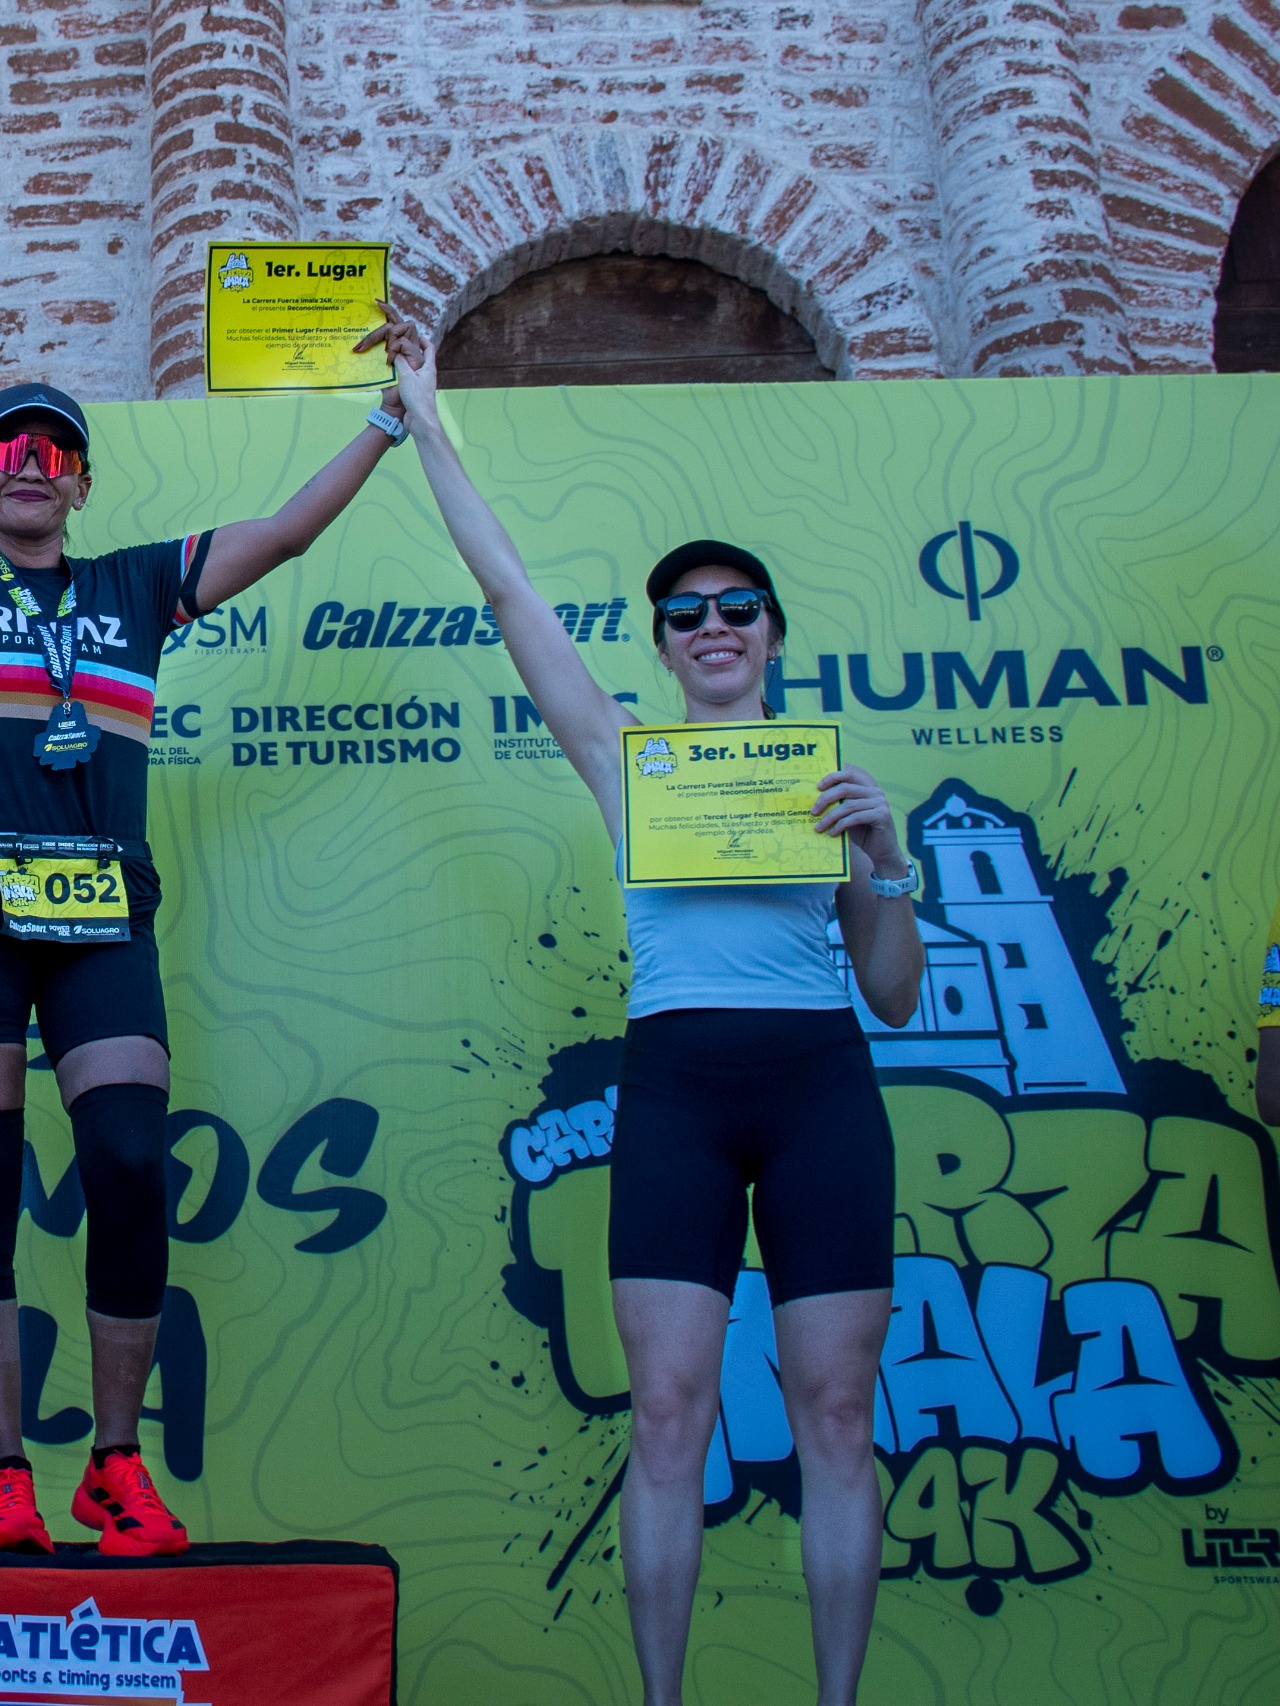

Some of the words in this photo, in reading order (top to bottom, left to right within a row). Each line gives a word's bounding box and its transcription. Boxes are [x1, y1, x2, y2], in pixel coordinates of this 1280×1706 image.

[265, 261, 301, 277] 1er.
[307, 261, 367, 280] Lugar
[302, 597, 628, 650] CalzzaSort
[230, 696, 460, 733] DIRECCIÓN
[911, 726, 1064, 746] WELLNESS
[168, 756, 202, 765] FÍSICA
[169, 747, 189, 755] DEL
[231, 742, 278, 766] DE
[286, 737, 461, 766] TURISMO
[495, 750, 511, 760] DE
[516, 749, 567, 759] CULTUR
[689, 744, 735, 761] 3er.
[743, 742, 817, 760] Lugar
[685, 790, 718, 799] presente
[720, 787, 783, 796] Reconocimiento
[729, 812, 752, 820] Lugar
[754, 810, 785, 818] Femenil
[787, 809, 811, 817] Gener
[44, 872, 120, 904] 052
[1205, 1503, 1229, 1524] by
[1214, 1575, 1280, 1584] SPORTSWEA
[42, 1670, 52, 1683] &
[58, 1669, 110, 1690] timing
[116, 1673, 176, 1689] system
